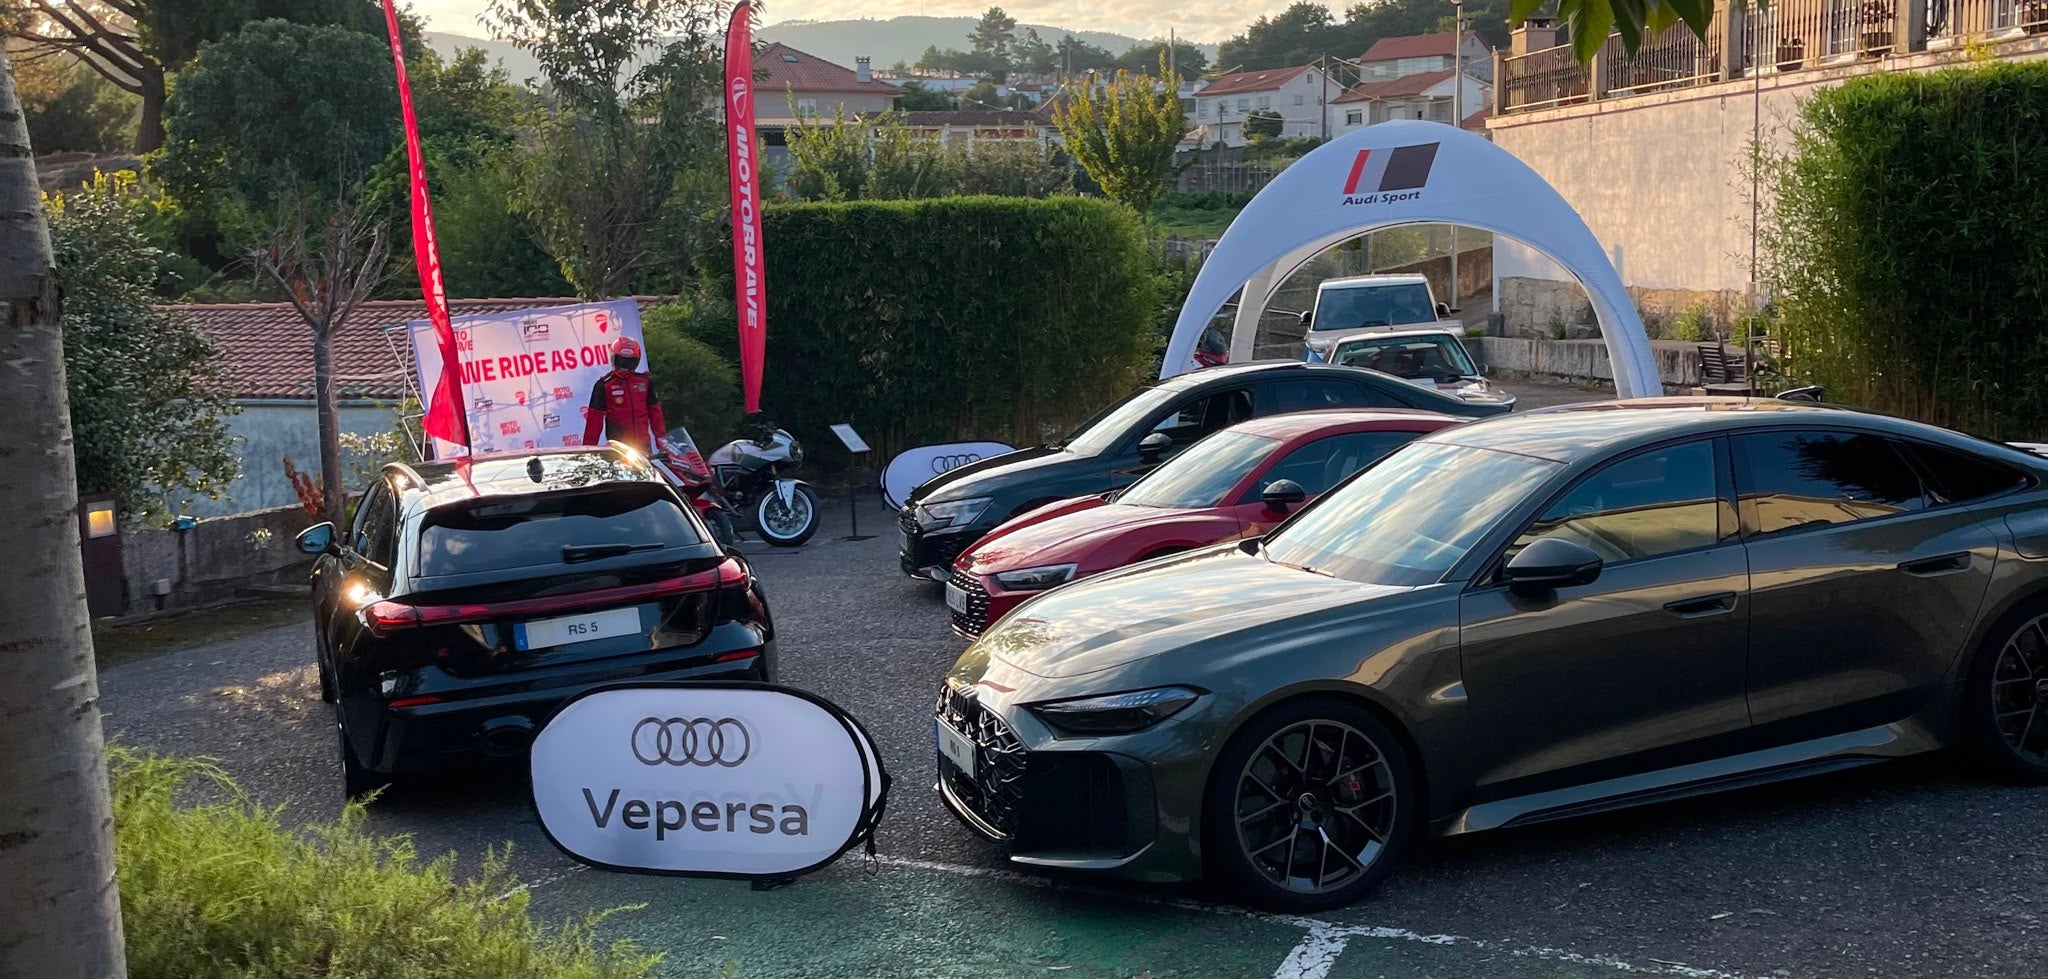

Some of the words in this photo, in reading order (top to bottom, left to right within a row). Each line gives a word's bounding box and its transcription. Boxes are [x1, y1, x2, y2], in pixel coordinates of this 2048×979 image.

[1342, 194, 1378, 205] Audi
[1381, 191, 1420, 205] Sport
[736, 124, 758, 329] MOTOBRAVE
[499, 352, 548, 379] RIDE
[551, 349, 578, 372] AS
[581, 343, 612, 367] ON
[568, 623, 587, 635] RS
[590, 622, 598, 632] 5
[582, 788, 808, 841] Vepersa
